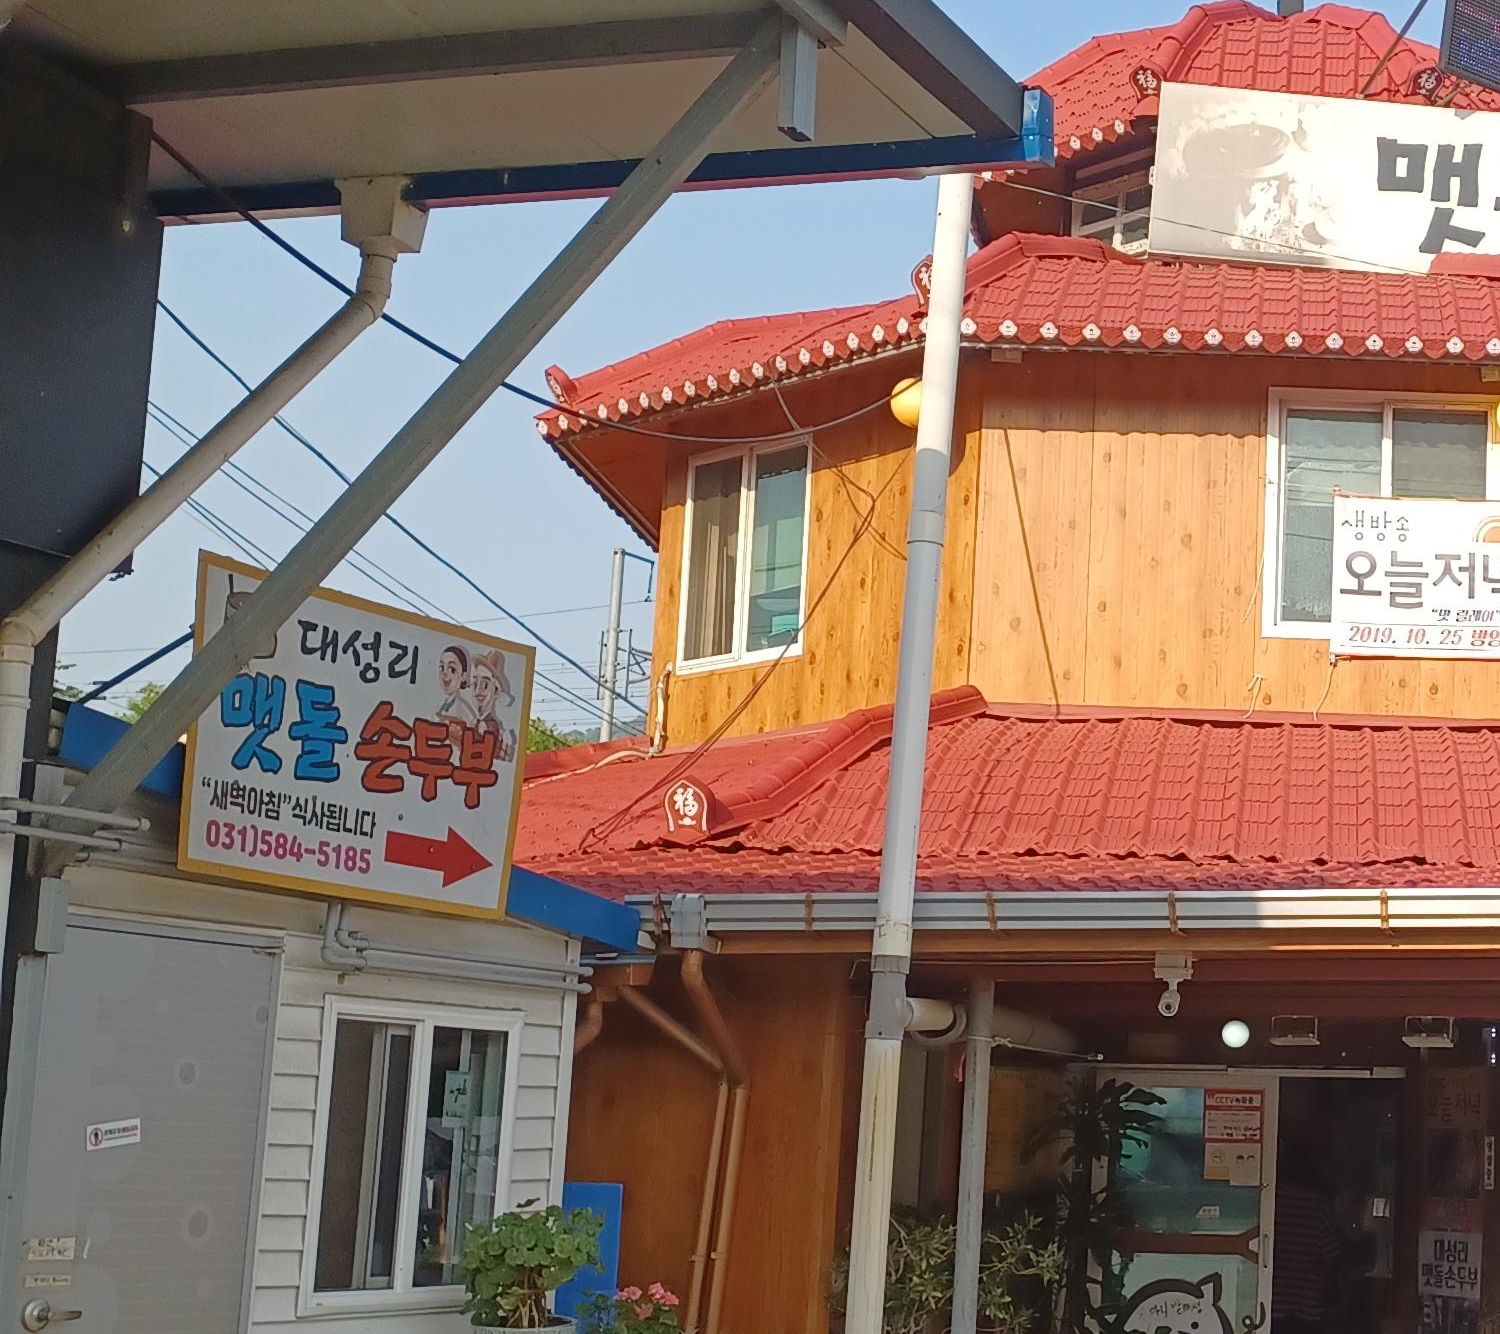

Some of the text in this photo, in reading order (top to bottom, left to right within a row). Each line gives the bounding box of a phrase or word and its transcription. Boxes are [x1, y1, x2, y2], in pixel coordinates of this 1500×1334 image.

[1341, 509, 1410, 543] 생방송
[297, 619, 420, 685] 대성리
[1349, 625, 1397, 645] 2019.
[1406, 627, 1430, 646] 10.
[1439, 628, 1464, 646] 25
[220, 670, 499, 810] 맷돌 손두부
[204, 818, 373, 876] 031)584-5185
[1433, 1239, 1469, 1265] 대성리
